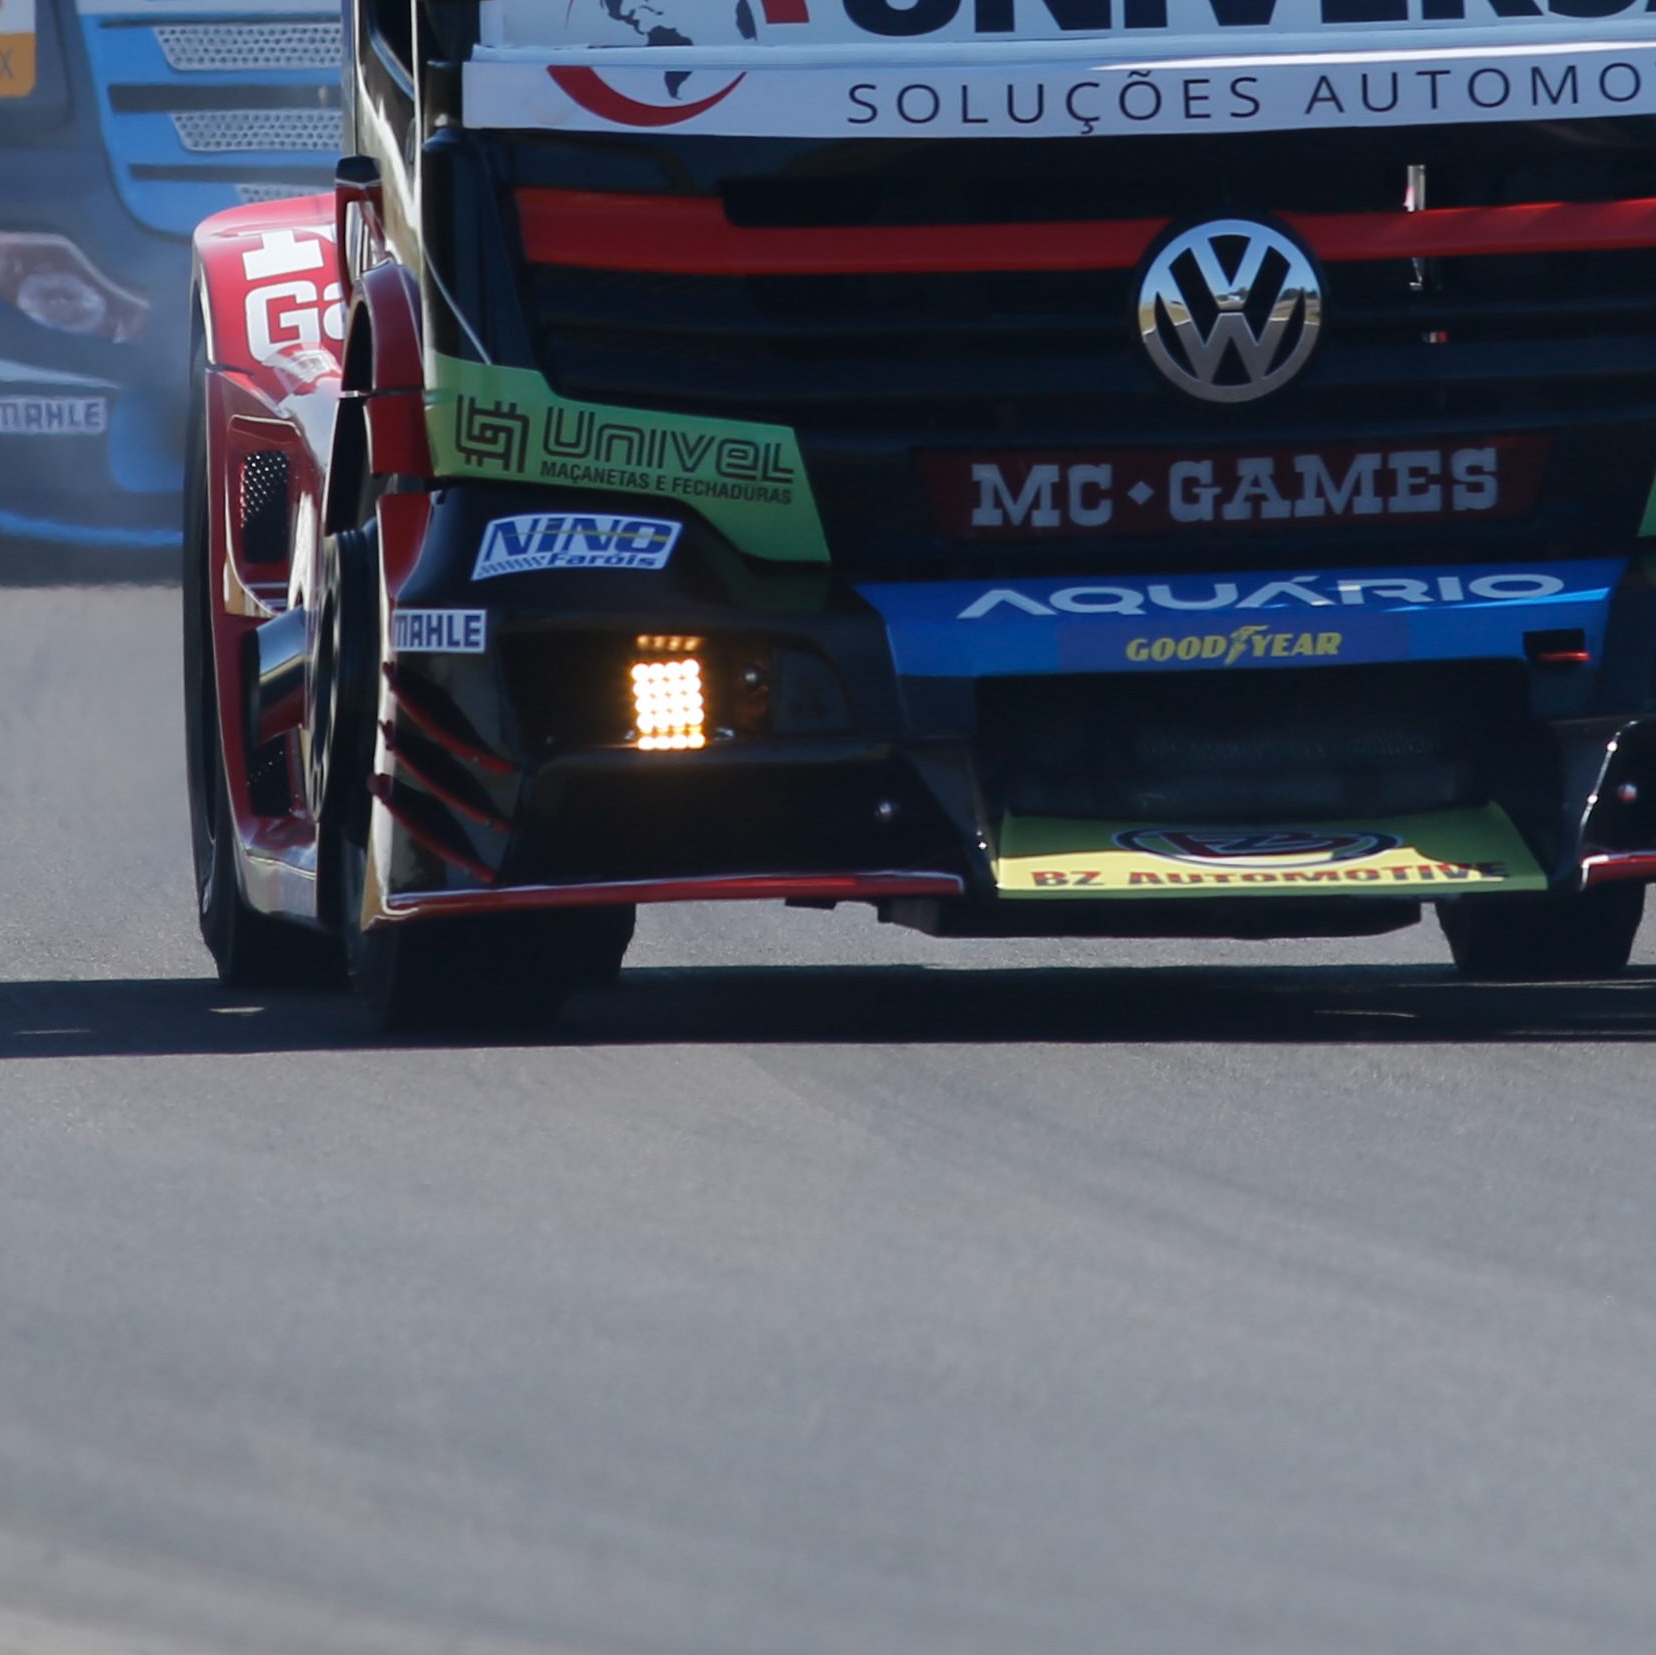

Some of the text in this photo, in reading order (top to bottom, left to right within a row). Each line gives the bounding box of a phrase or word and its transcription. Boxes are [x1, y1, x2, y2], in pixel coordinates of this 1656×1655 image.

[847, 70, 1261, 134] SOLUÇÕES
[540, 460, 792, 505] MAÇANETAS E FECHADURAS
[956, 573, 1564, 619] AQUÁRIO
[396, 614, 481, 649] MAHLE
[1032, 860, 1513, 889] BZ AUTOMOTIVE
